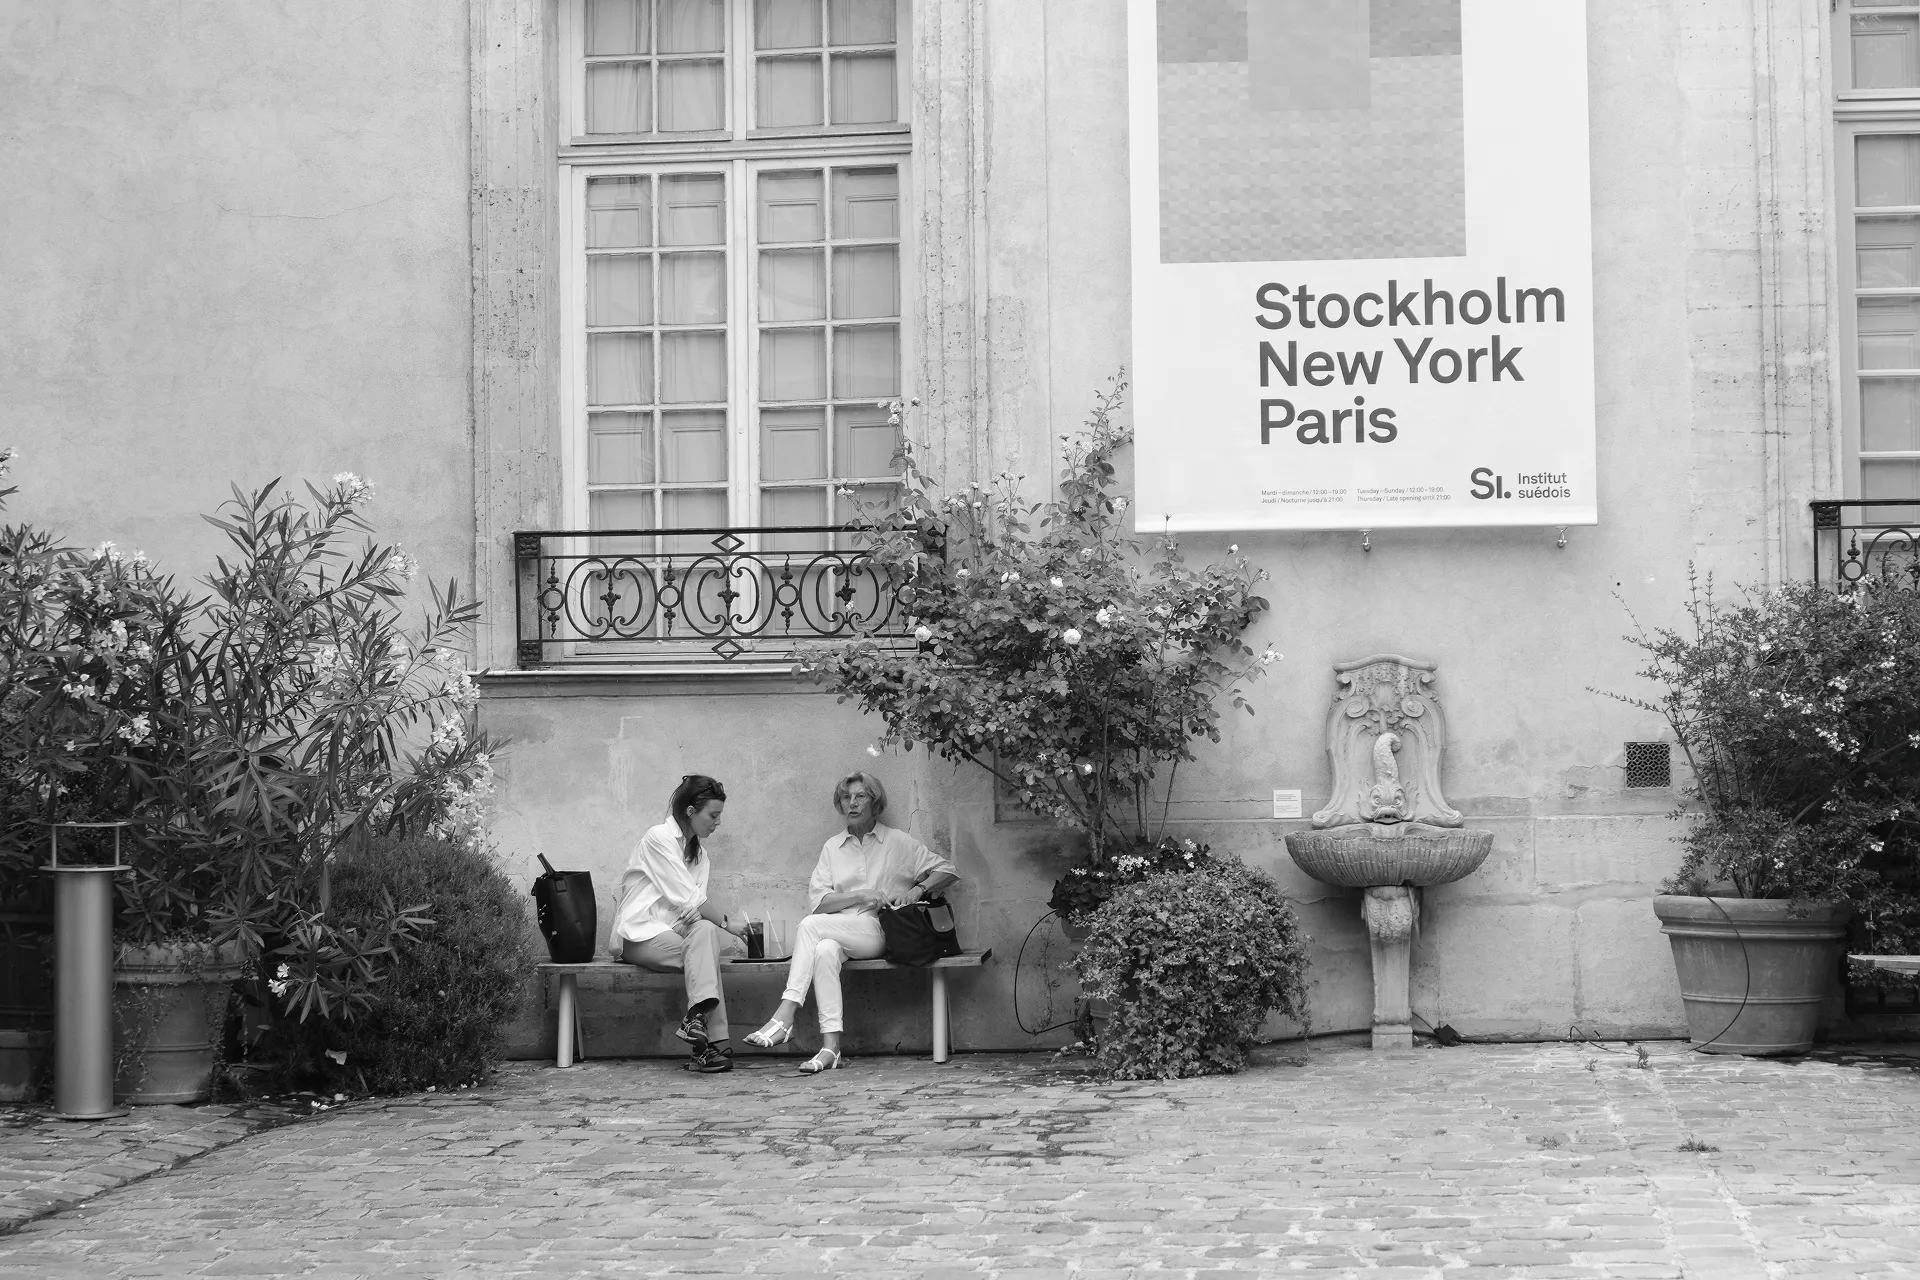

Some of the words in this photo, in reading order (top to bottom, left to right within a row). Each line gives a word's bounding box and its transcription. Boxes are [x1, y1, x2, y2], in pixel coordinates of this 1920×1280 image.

[1255, 276, 1565, 330] Stockholm
[1260, 341, 1384, 387] New
[1393, 335, 1524, 384] York
[1260, 396, 1398, 445] Paris
[1518, 472, 1567, 484] Institut
[1518, 486, 1570, 498] suédois
